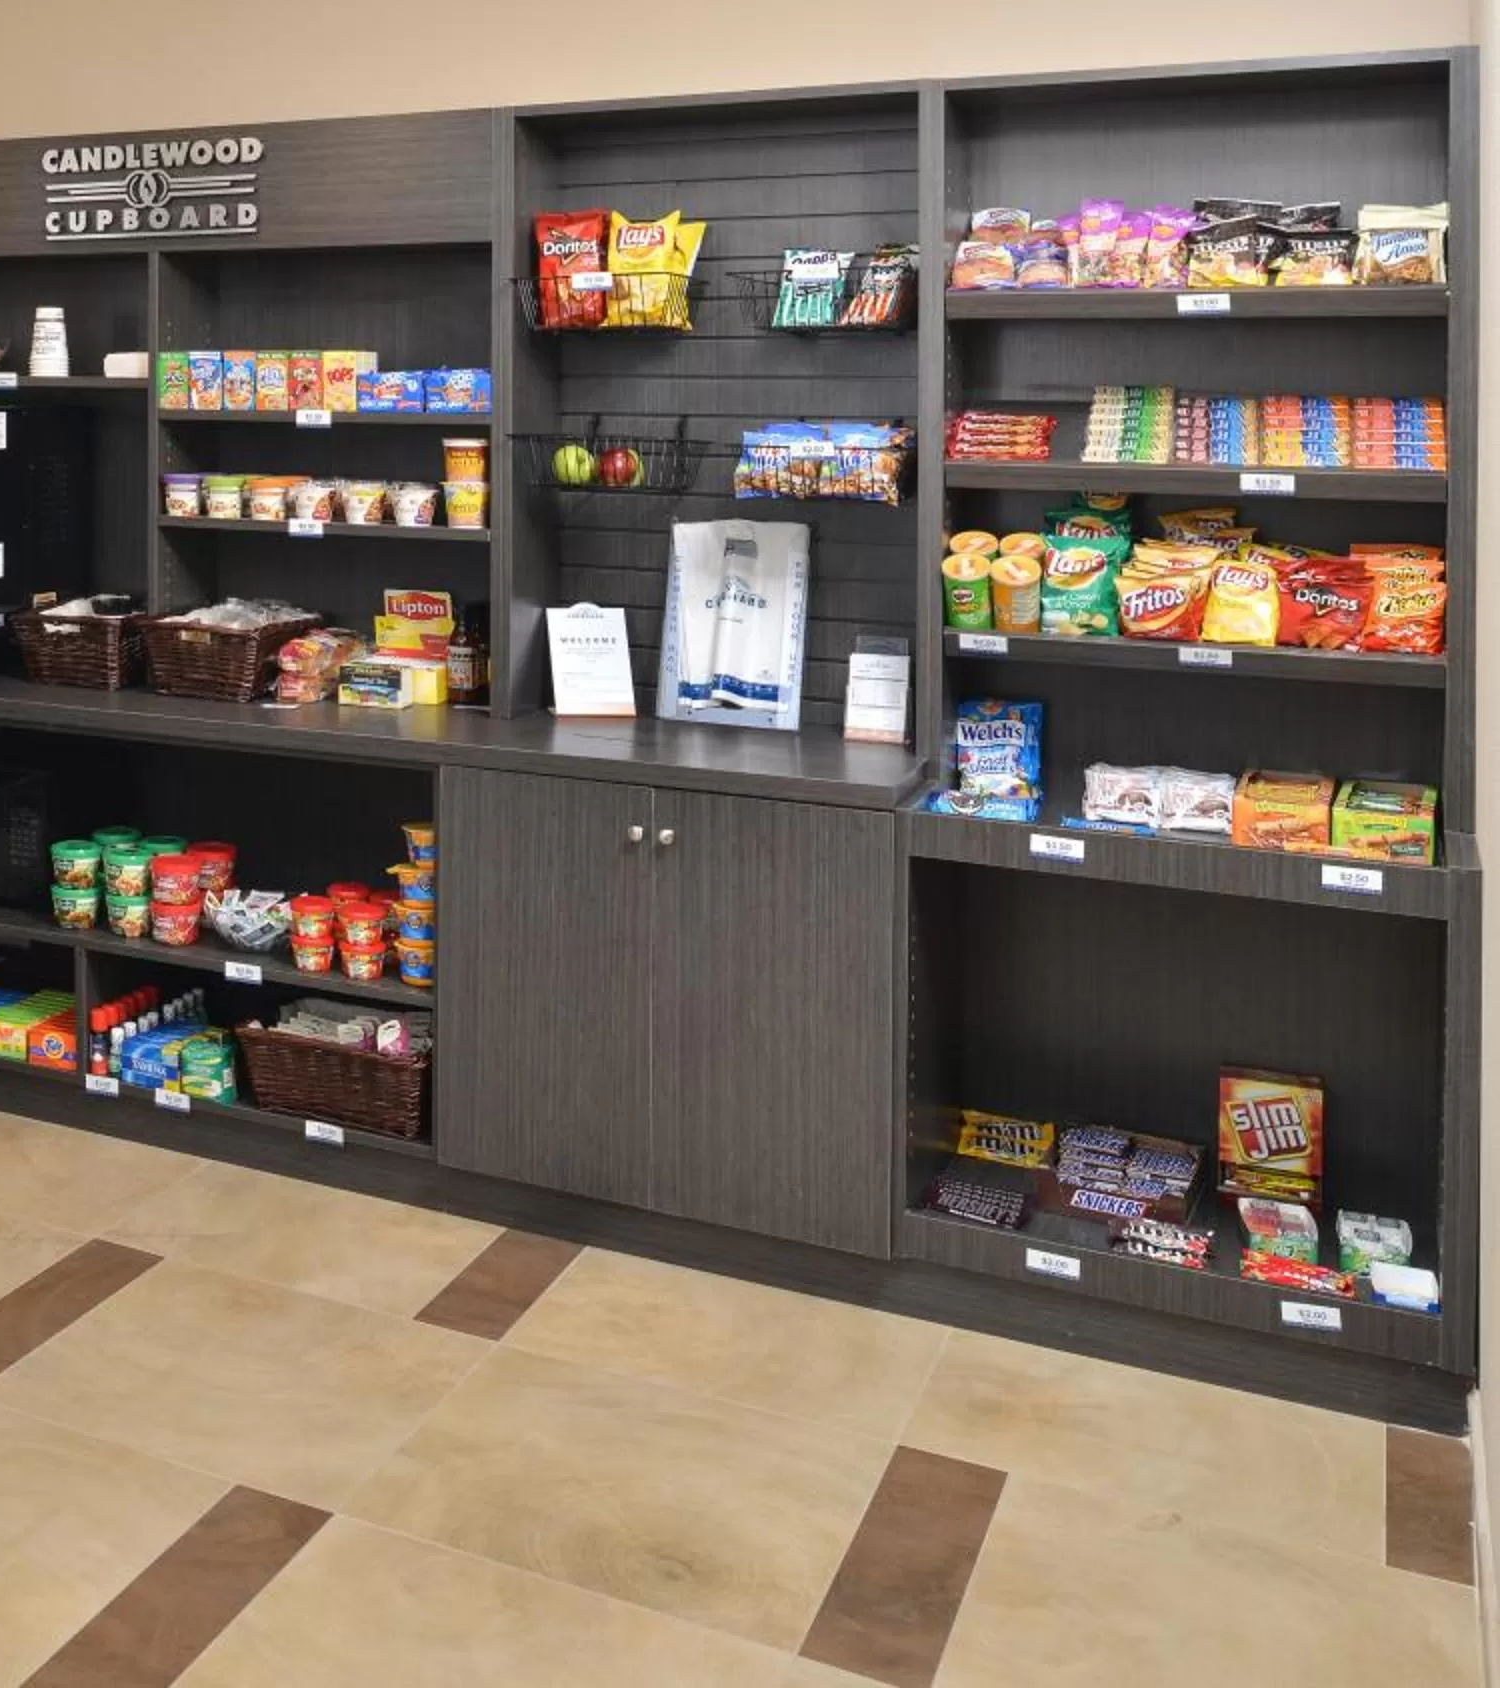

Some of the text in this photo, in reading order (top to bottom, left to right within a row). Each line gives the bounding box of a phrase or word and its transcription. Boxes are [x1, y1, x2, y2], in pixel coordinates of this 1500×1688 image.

[41, 136, 263, 173] CANDLEWOOD
[45, 202, 258, 233] CUPBOARD
[542, 239, 598, 256] Doritos
[393, 599, 446, 617] Lipton
[1124, 585, 1187, 618] Fritos
[1294, 588, 1359, 612] Doritos
[959, 722, 1024, 742] Welch's
[1231, 1100, 1302, 1132] slim
[1250, 1124, 1307, 1159] jim
[1073, 1190, 1145, 1218] SNICKERS
